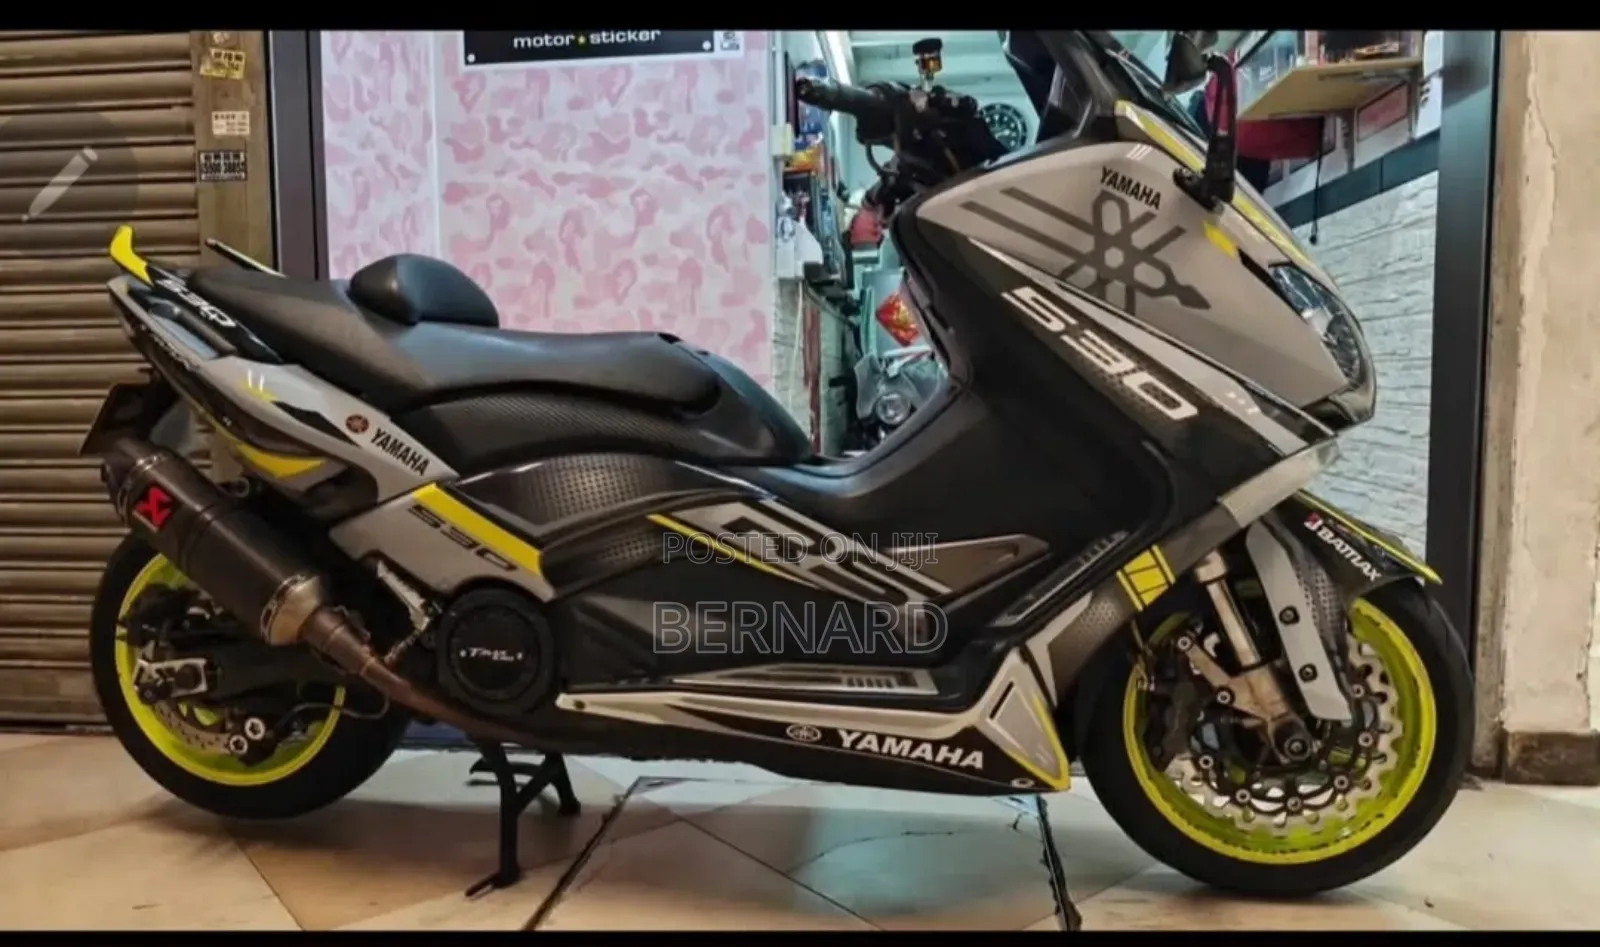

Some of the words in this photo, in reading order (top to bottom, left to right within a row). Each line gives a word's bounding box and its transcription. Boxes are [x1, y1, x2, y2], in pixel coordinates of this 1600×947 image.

[513, 33, 577, 49] motor
[589, 30, 661, 45] sticker
[1100, 166, 1163, 210] YAMAHA
[1001, 286, 1198, 420] 530
[370, 428, 430, 476] YAMAHA
[407, 504, 519, 571] 530
[837, 729, 985, 770] YAMAHA
